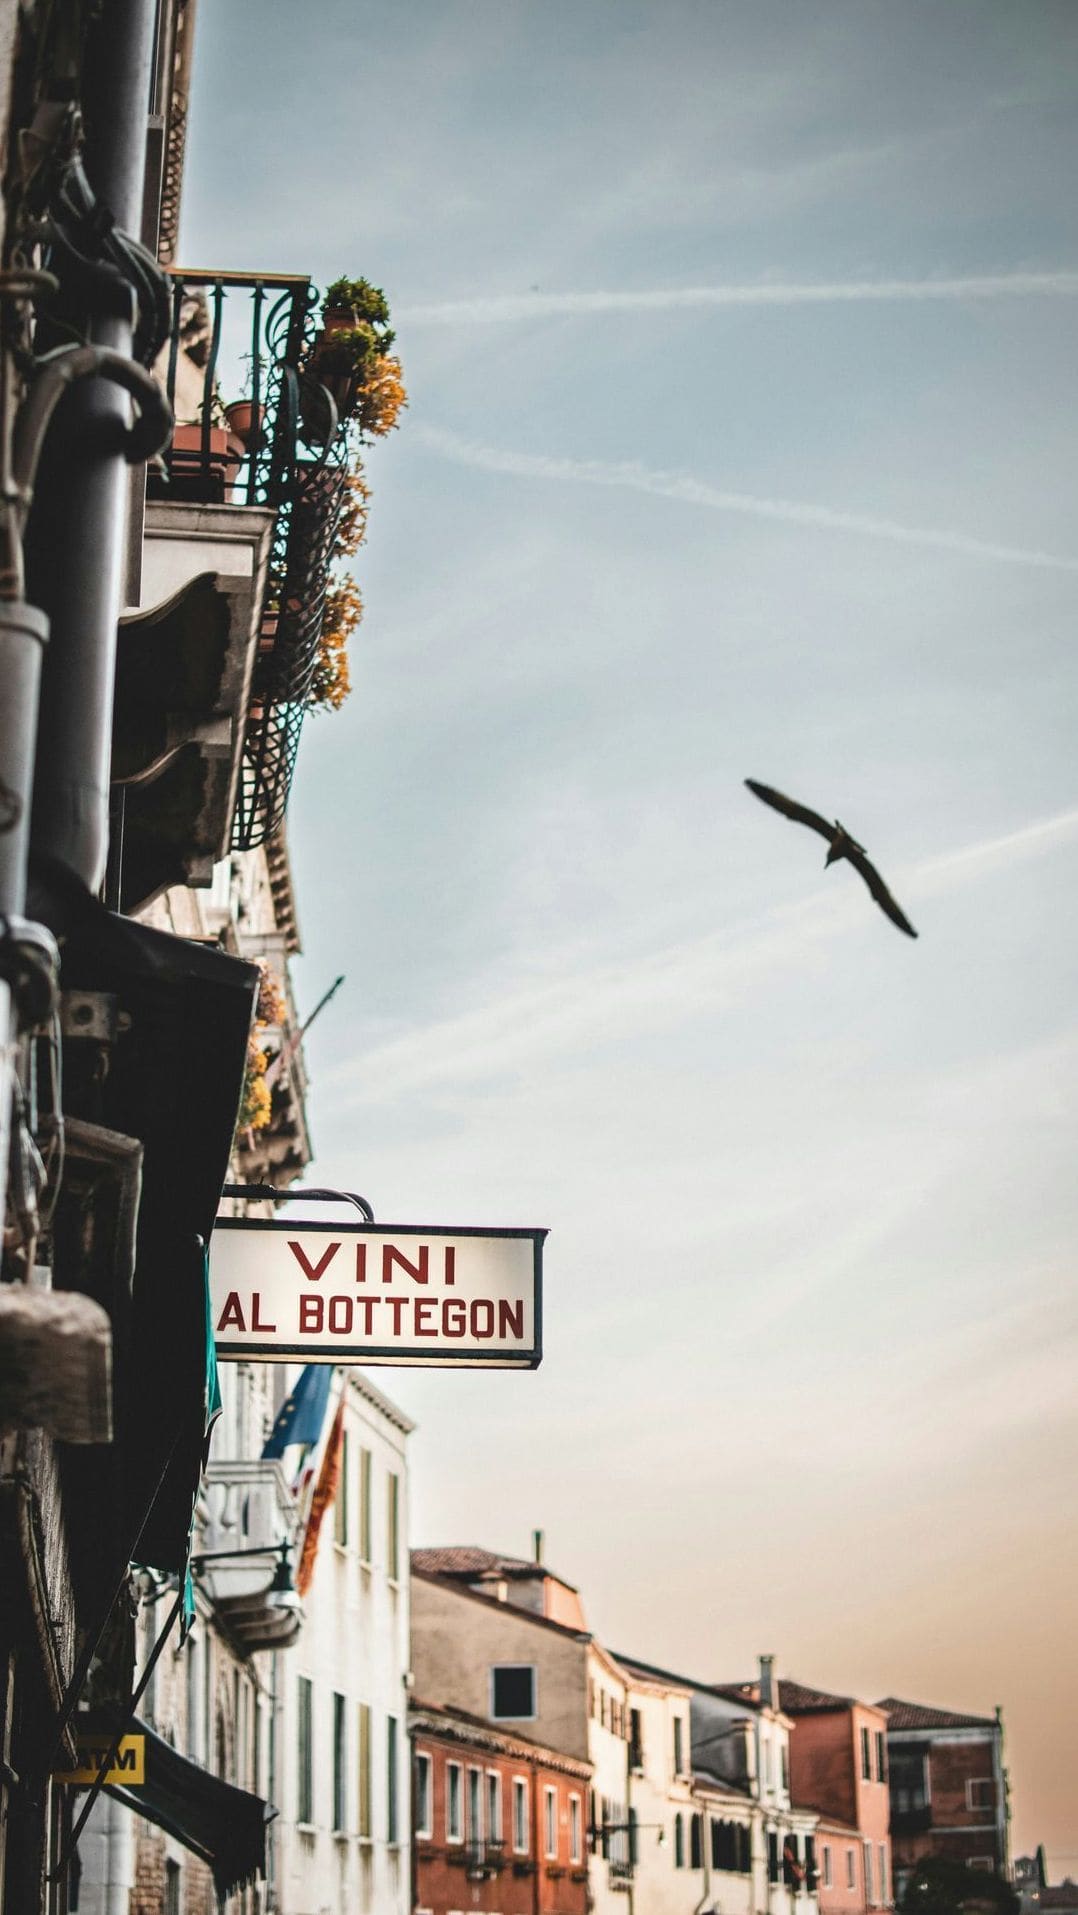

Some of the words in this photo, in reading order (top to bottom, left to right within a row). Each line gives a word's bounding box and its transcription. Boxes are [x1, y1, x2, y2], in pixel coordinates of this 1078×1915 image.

[287, 1241, 455, 1286] VINI
[216, 1291, 277, 1333] AL
[299, 1294, 524, 1339] BOTTEGON
